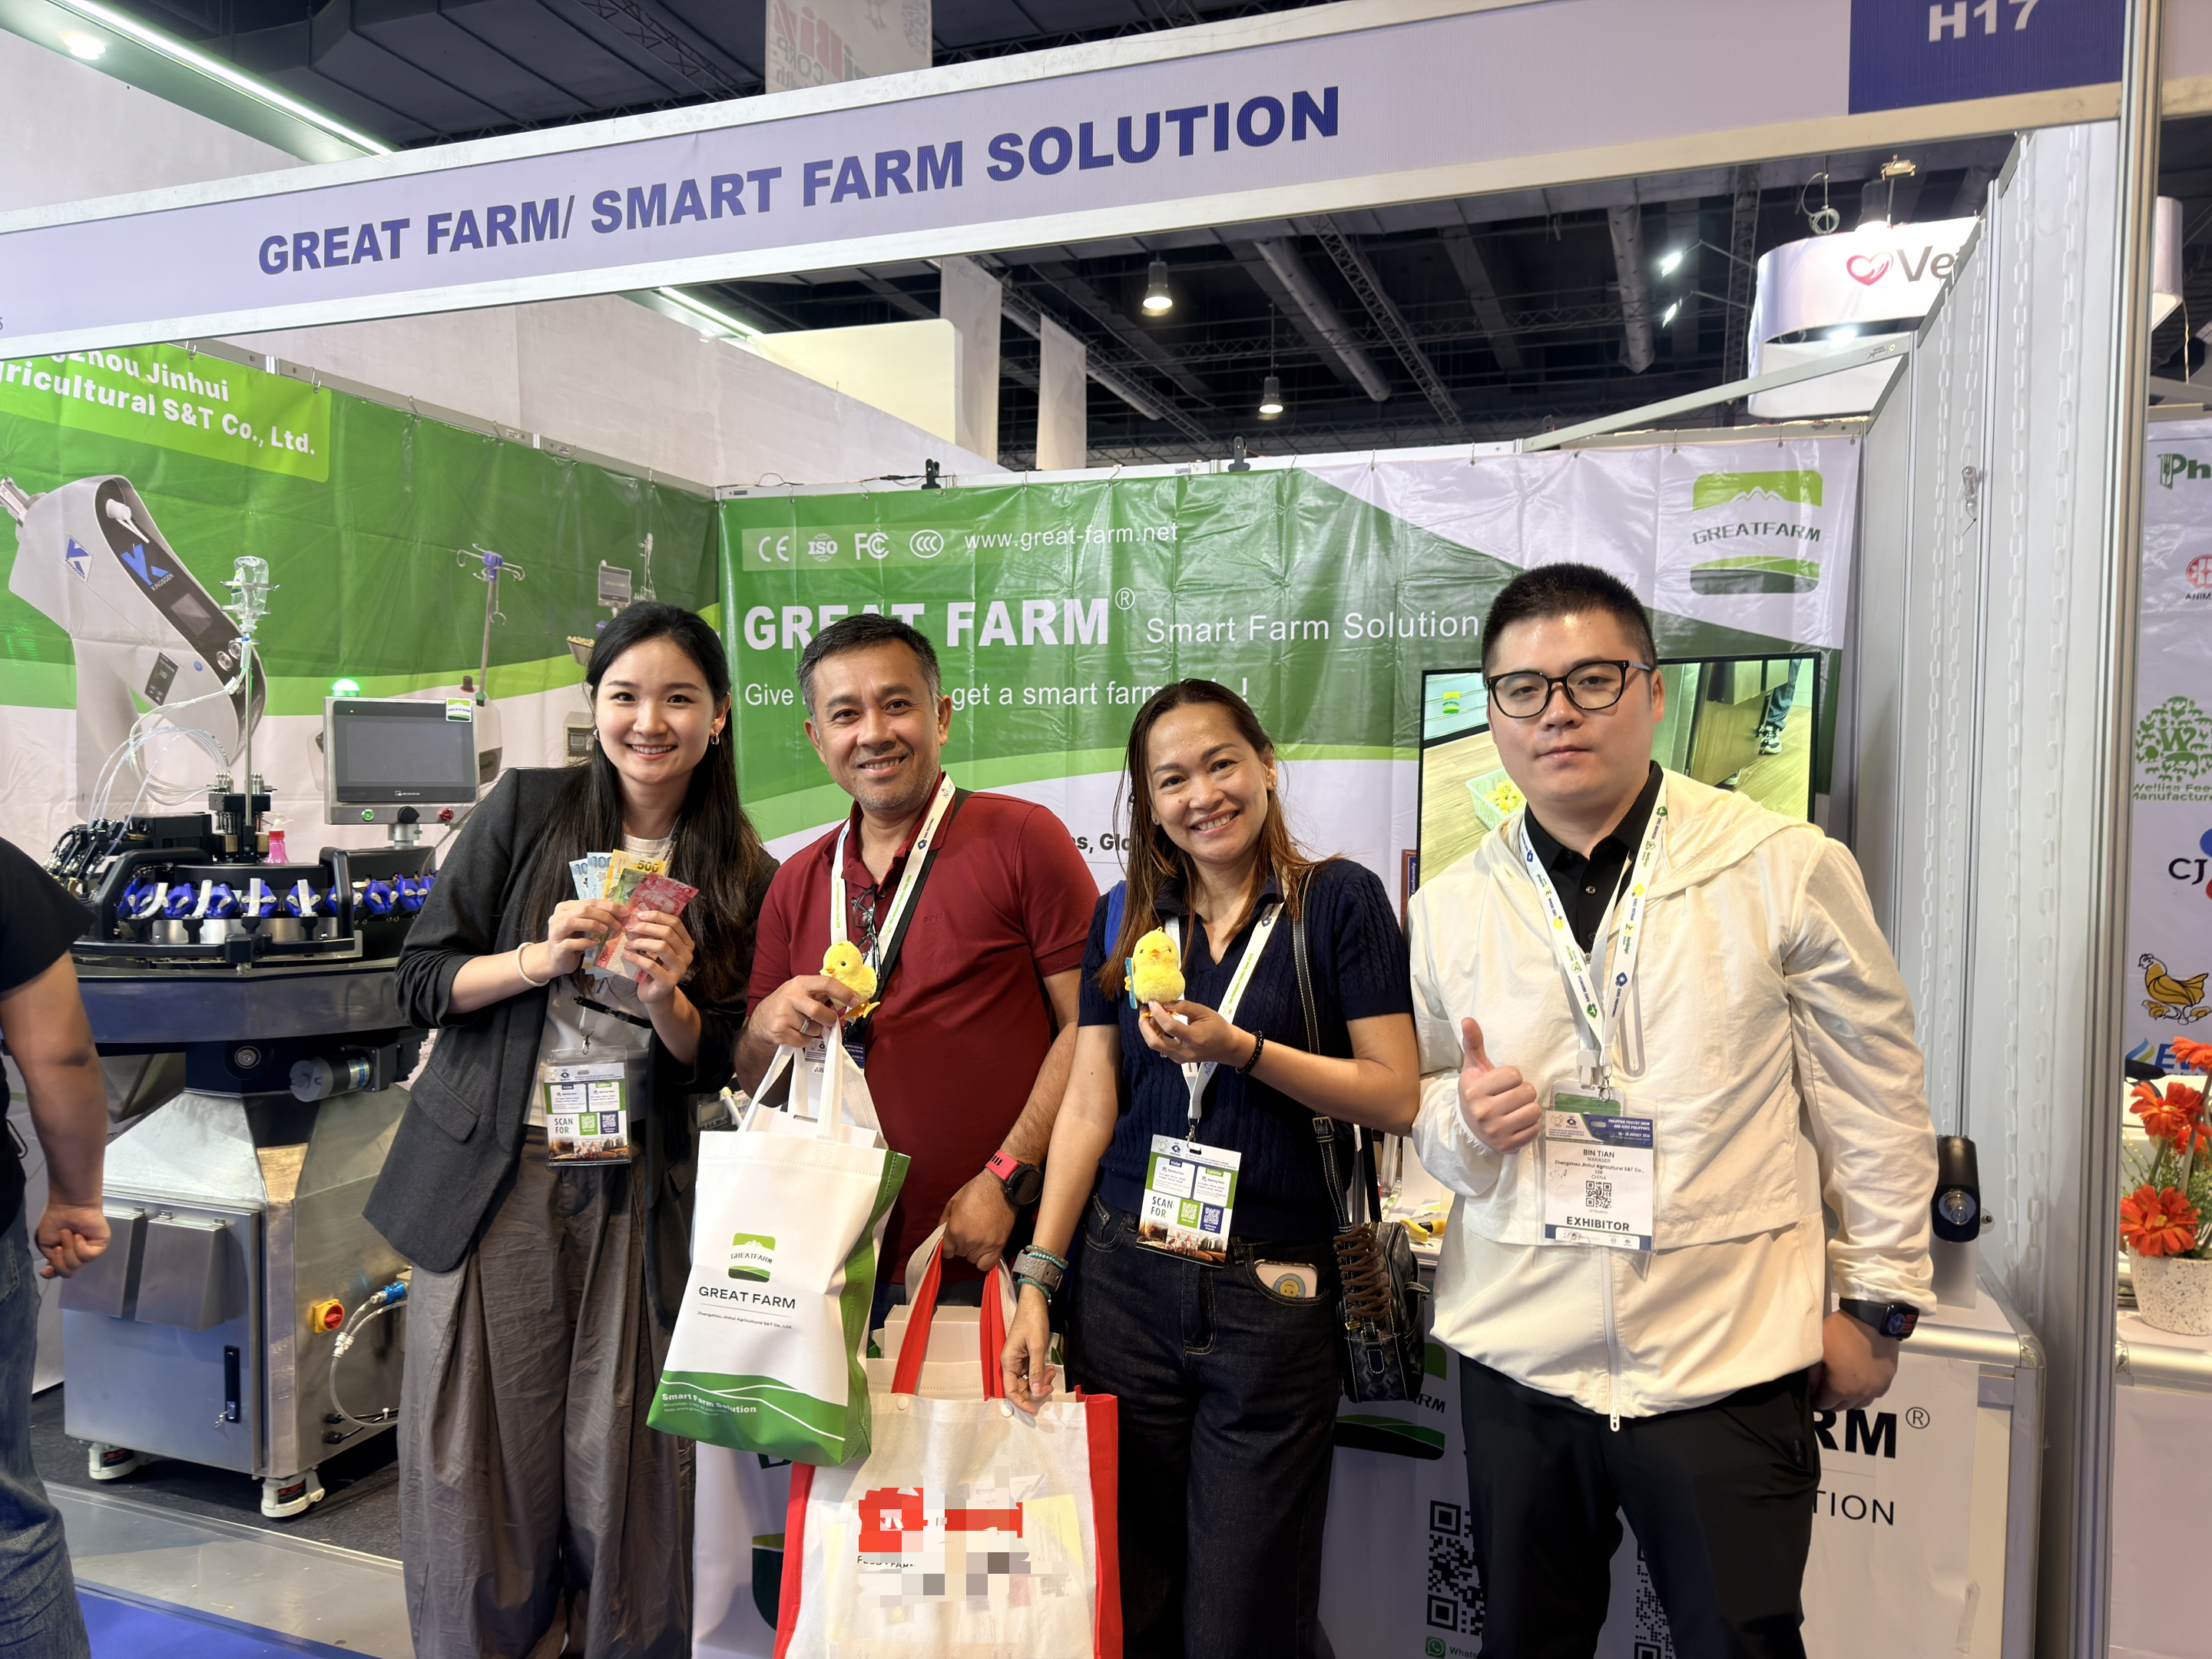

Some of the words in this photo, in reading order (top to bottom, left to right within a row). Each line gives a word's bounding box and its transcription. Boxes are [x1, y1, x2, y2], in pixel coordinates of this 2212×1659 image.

[1929, 0, 2039, 41] H17
[259, 219, 410, 276] GREAT
[427, 195, 575, 255] FARM/
[591, 167, 783, 234] SMART
[803, 141, 963, 207] FARM
[986, 87, 1339, 181] SOLUTION
[147, 363, 229, 402] Jinhui
[0, 360, 155, 416] ricultural
[163, 398, 214, 429] S&T
[222, 413, 264, 448] Co.,
[271, 425, 315, 455] Ltd.
[2157, 453, 2212, 490] Ph
[965, 522, 1178, 551] www.great-farm.net
[1692, 522, 1821, 545] GREATFARM
[808, 541, 838, 555] ISO
[947, 598, 1109, 647] FARM
[1147, 617, 1236, 644] Smart
[1249, 615, 1330, 641] Farm
[1343, 611, 1479, 639] Solution
[745, 682, 793, 706] Give
[952, 682, 990, 711] get
[998, 688, 1013, 706] a
[1023, 682, 1098, 706] smart
[2186, 783, 2212, 792] Fee
[575, 863, 588, 875] 10
[637, 860, 660, 873] 500
[2168, 857, 2208, 886] CJ
[674, 883, 691, 894] 50
[1151, 1206, 1167, 1218] FOR
[1152, 1196, 1173, 1209] SCAN
[1566, 1216, 1630, 1232] EXHIBITOR
[730, 1252, 773, 1264] GREATFARM
[699, 1286, 749, 1302] GREAT
[753, 1293, 796, 1310] FARM
[697, 1310, 722, 1319] Zhengzhou
[737, 1316, 763, 1325] Agricultural
[661, 1392, 692, 1401] Smart
[693, 1395, 714, 1407] Farm
[715, 1402, 757, 1413] Solution
